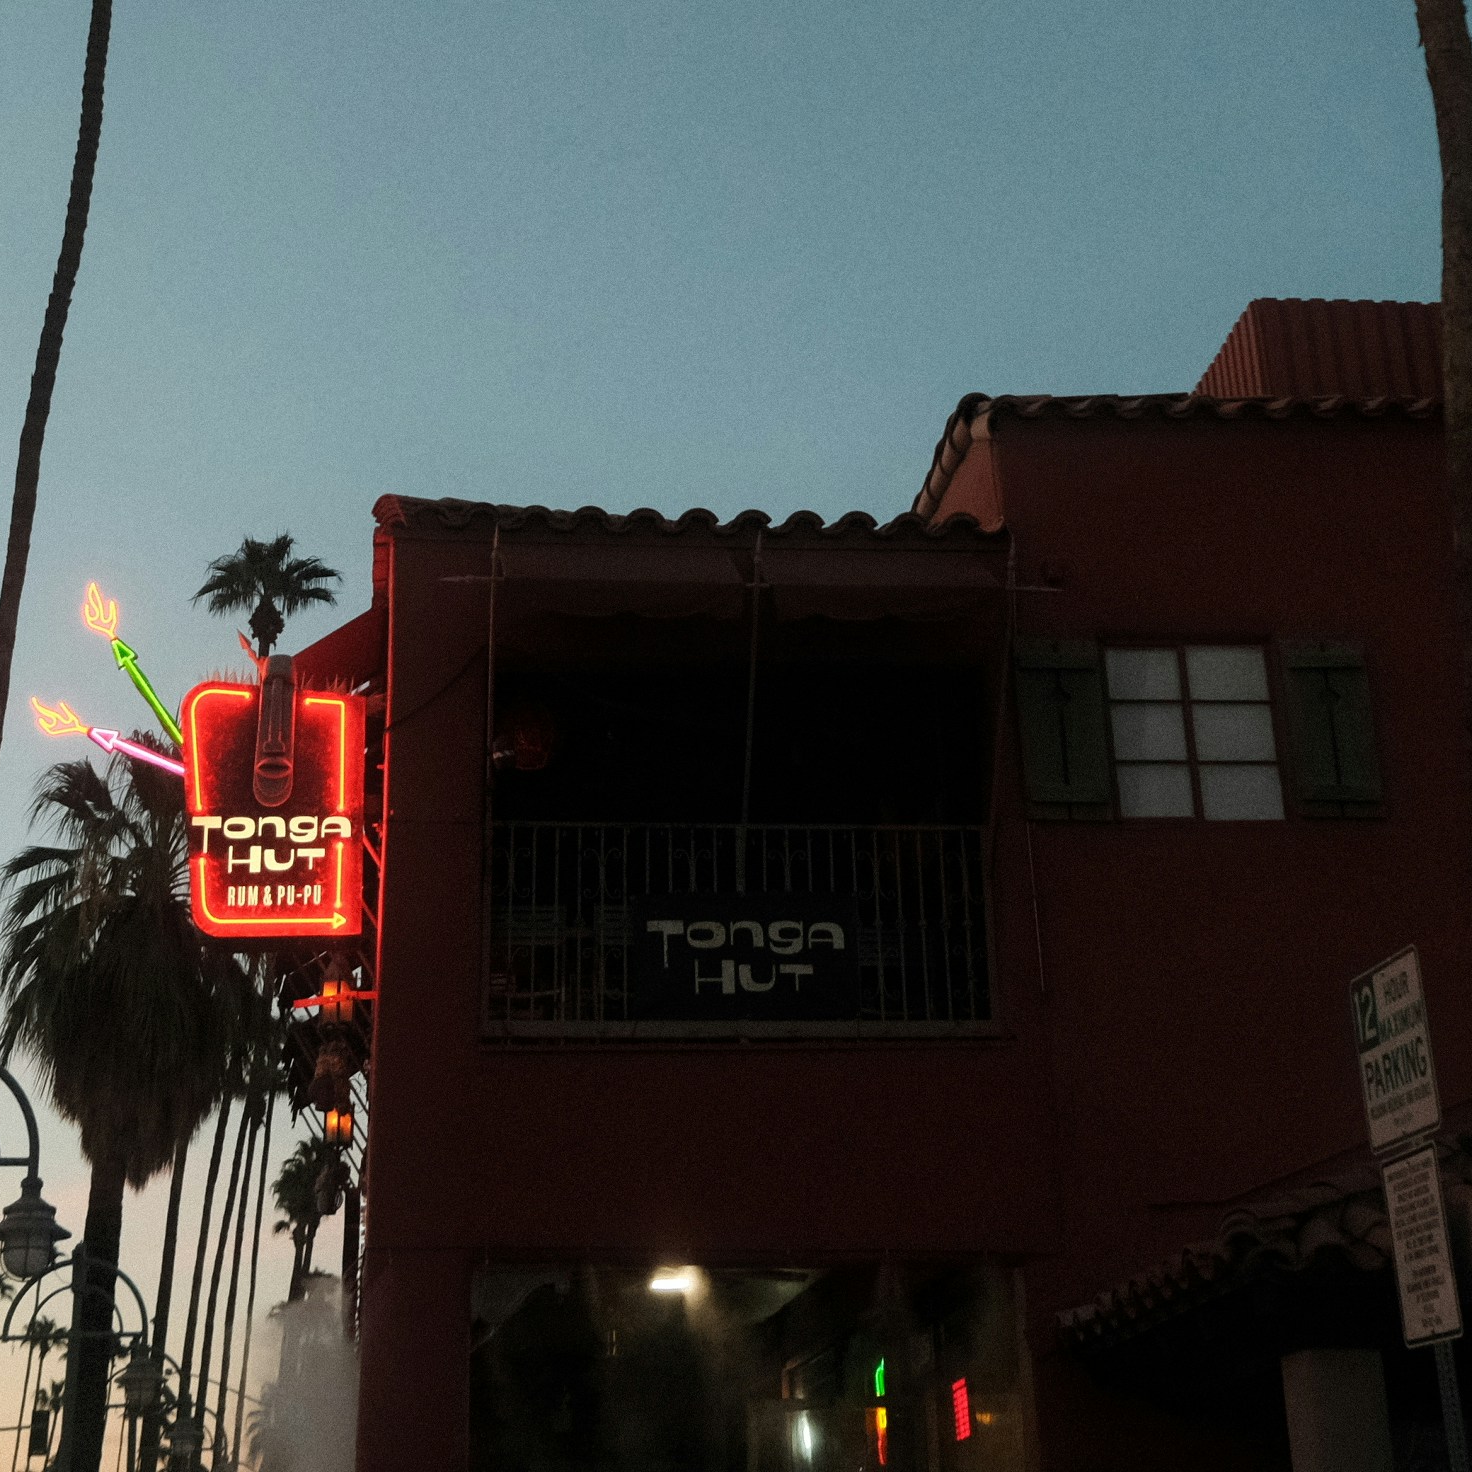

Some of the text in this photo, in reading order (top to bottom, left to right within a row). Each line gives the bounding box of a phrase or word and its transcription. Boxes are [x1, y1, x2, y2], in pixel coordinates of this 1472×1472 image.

[227, 845, 326, 874] HUT
[227, 884, 322, 907] RUM & PU-PU
[694, 958, 815, 996] HUT
[1353, 986, 1377, 1043] 12
[1365, 1036, 1428, 1101] PARKING
